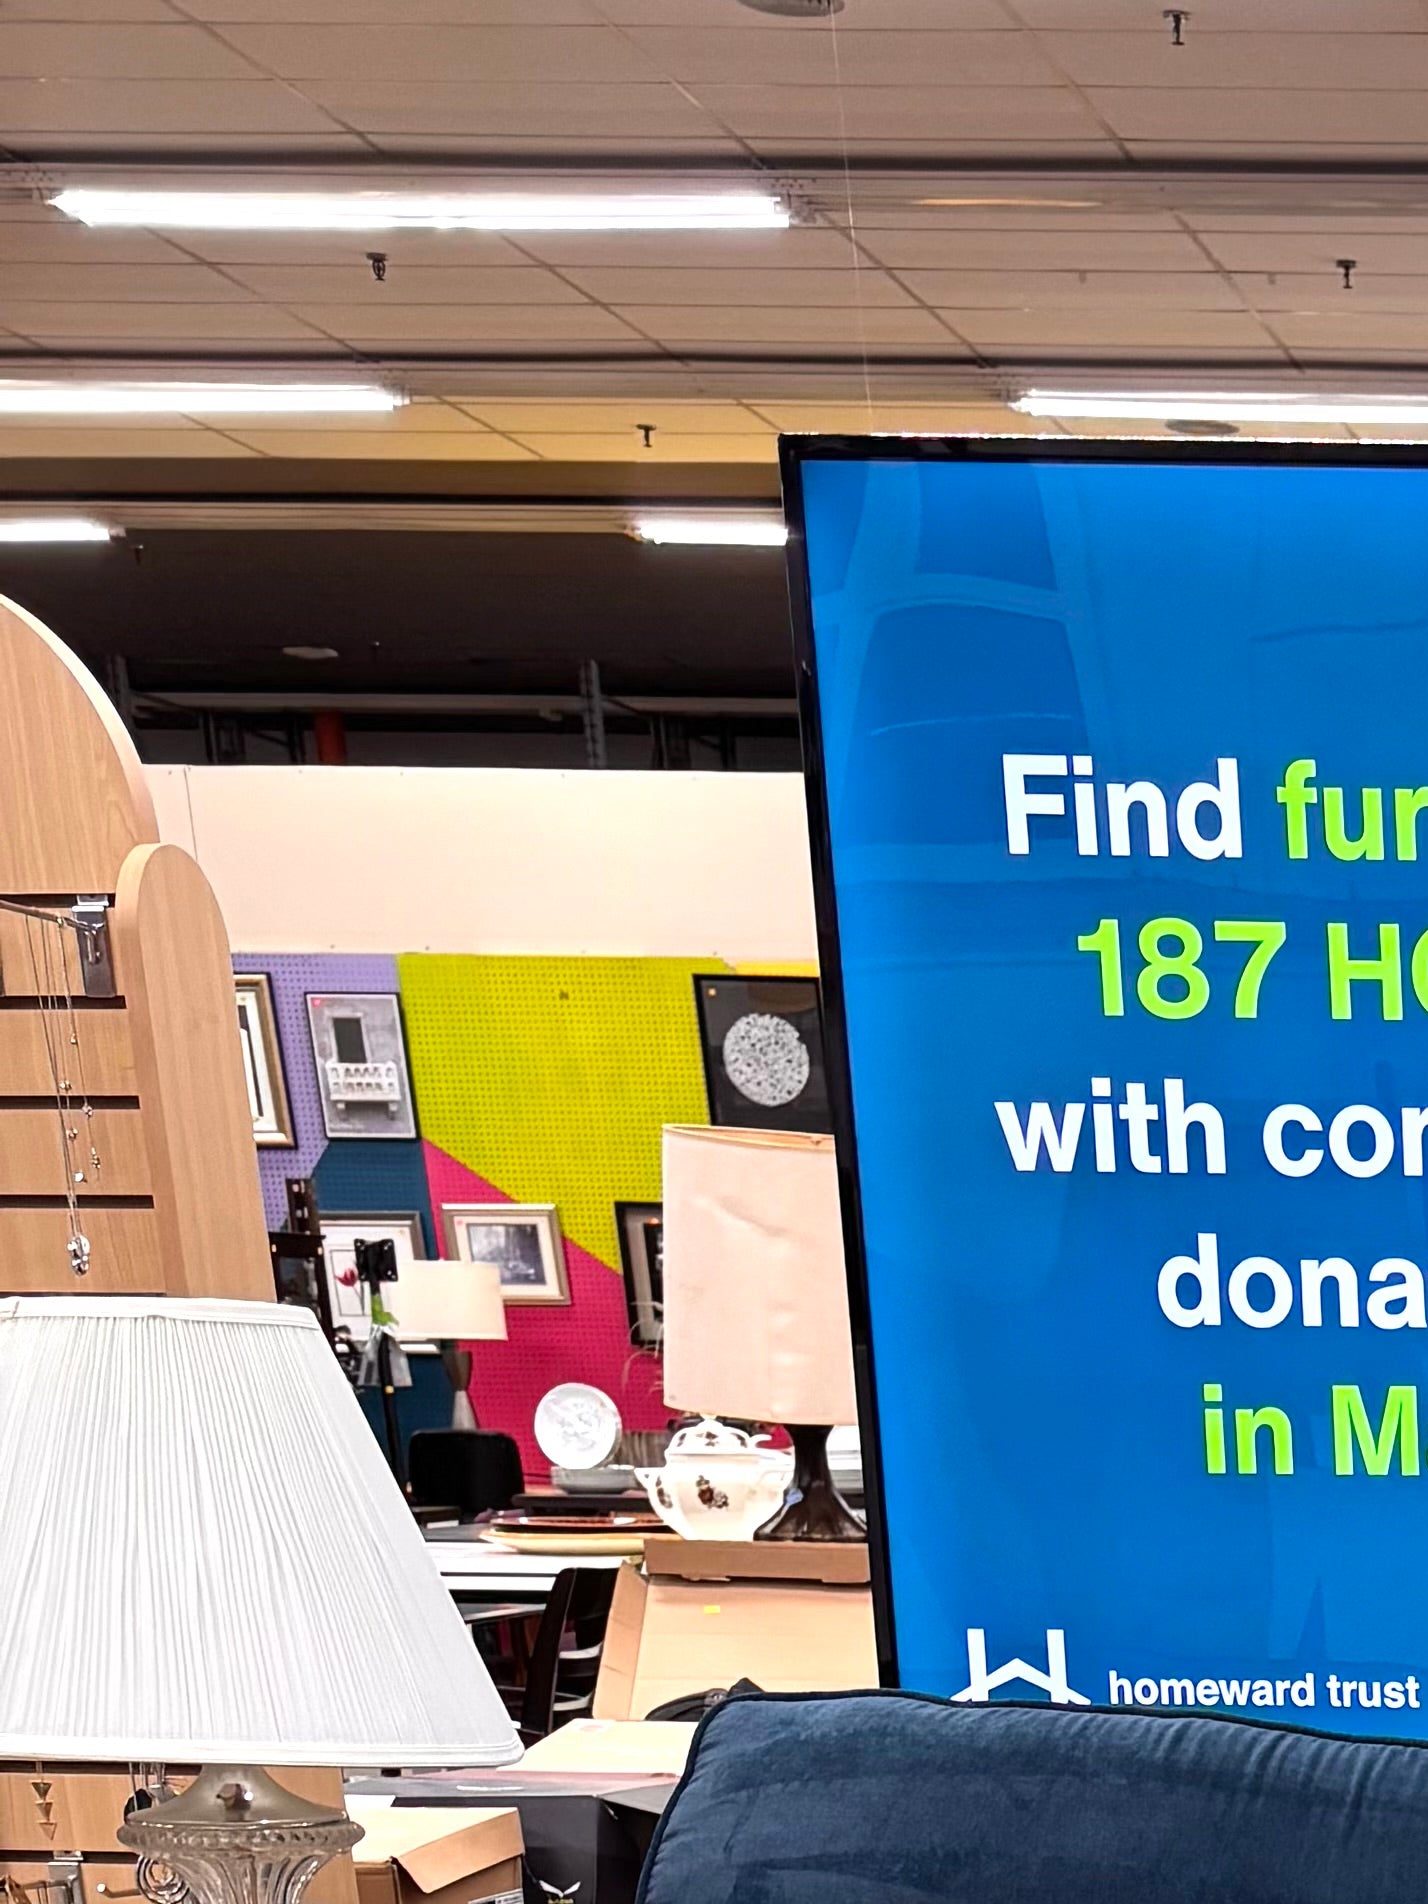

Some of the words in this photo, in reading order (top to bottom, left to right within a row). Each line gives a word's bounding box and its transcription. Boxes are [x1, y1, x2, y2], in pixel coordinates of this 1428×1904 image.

[1001, 753, 1242, 861] Find
[1077, 917, 1287, 1020] 187
[994, 1078, 1227, 1176] with
[1200, 1382, 1295, 1478] in
[1109, 1670, 1315, 1707] homeward
[1326, 1674, 1420, 1709] trust
